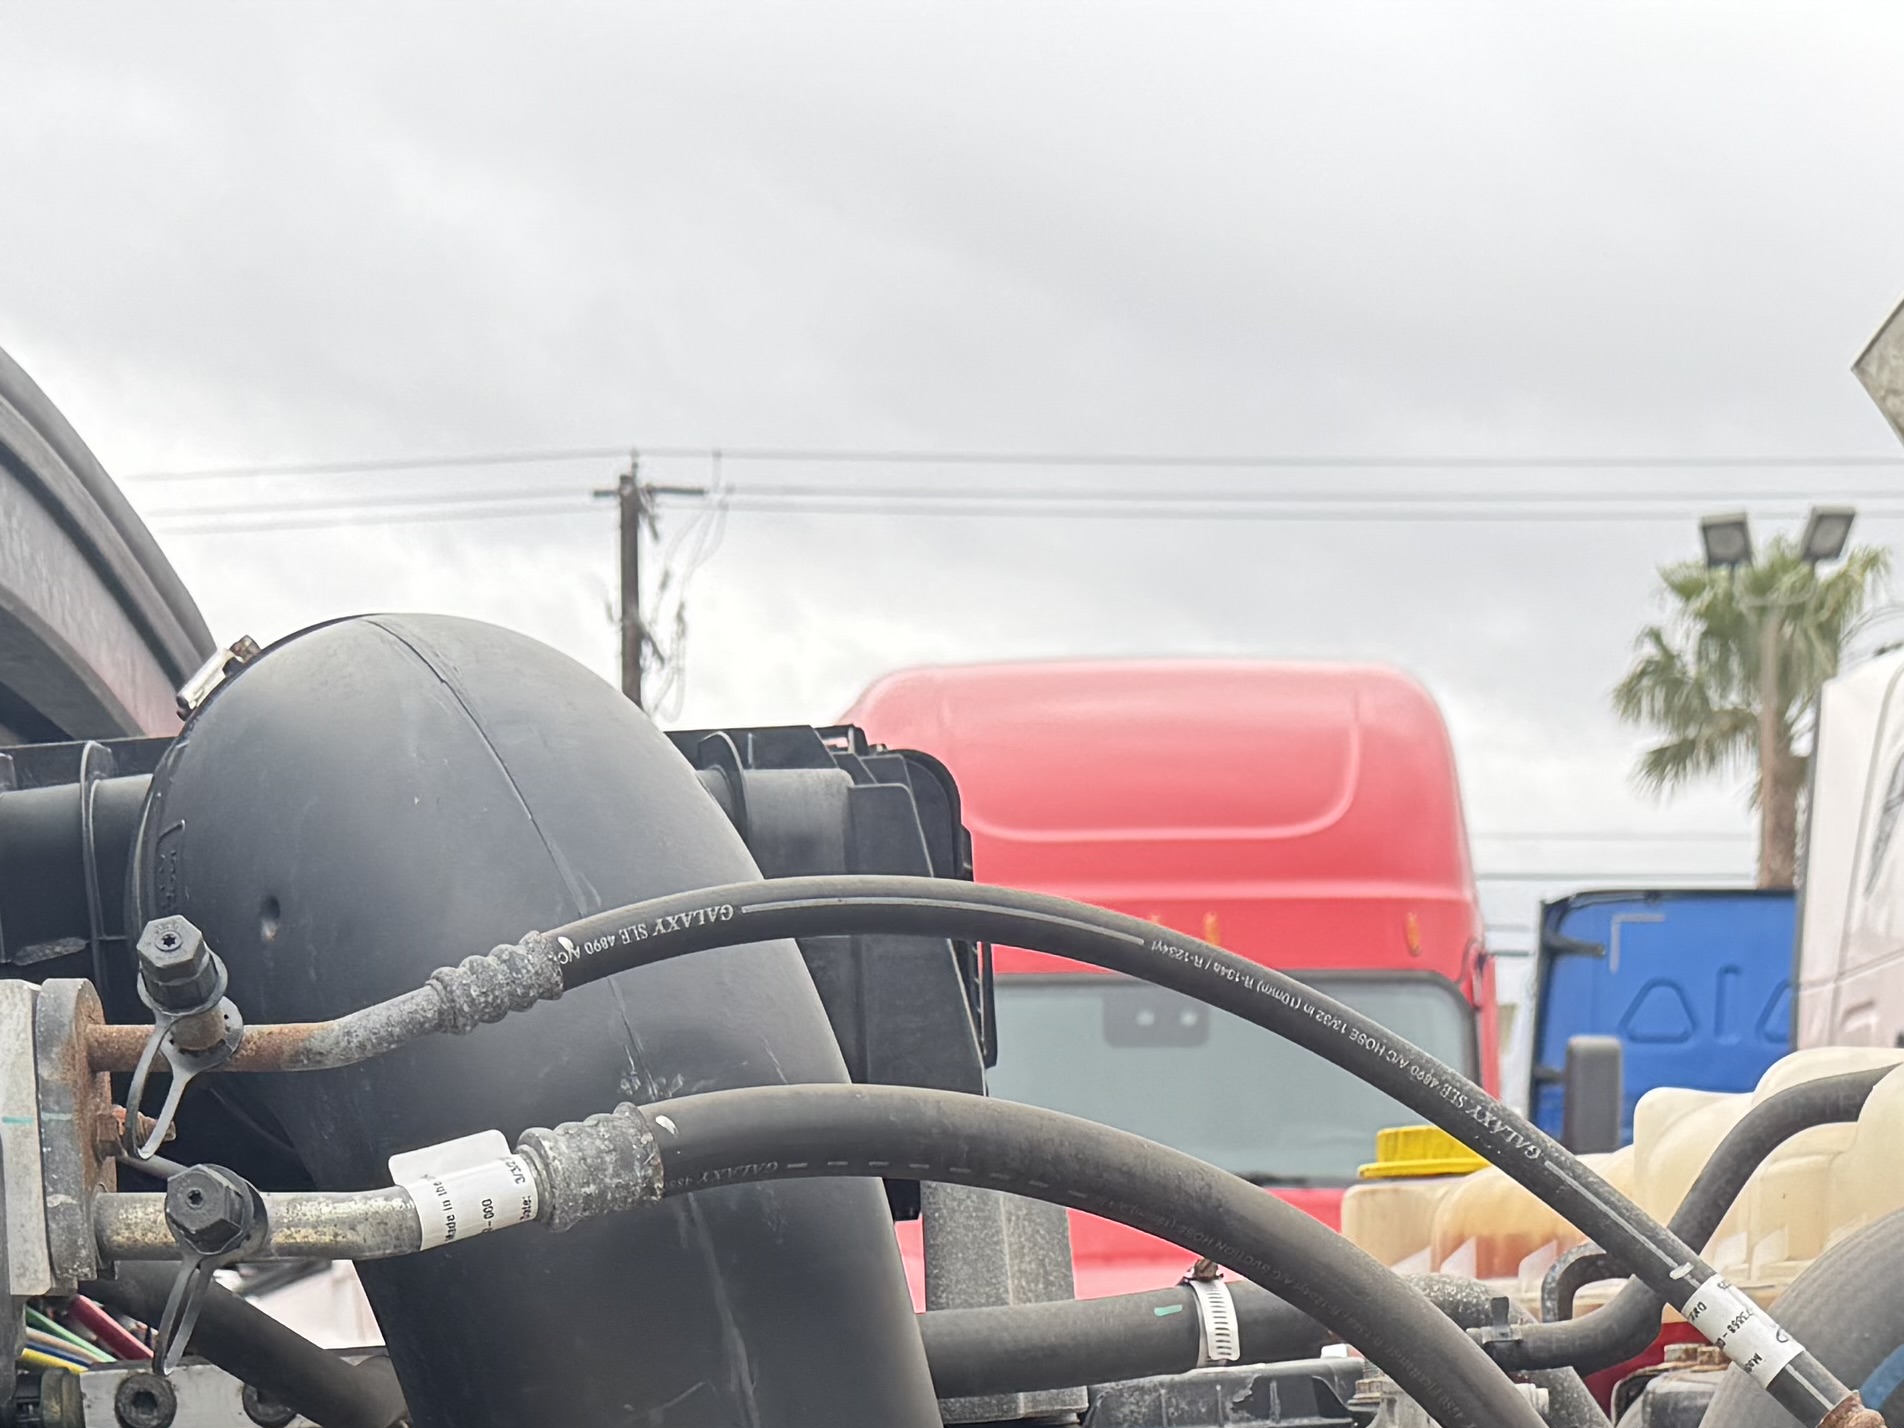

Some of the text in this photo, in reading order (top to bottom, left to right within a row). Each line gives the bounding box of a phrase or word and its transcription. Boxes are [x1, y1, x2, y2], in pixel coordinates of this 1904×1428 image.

[618, 923, 648, 944] SLE
[652, 905, 734, 936] GALAXY
[584, 935, 615, 955] 4890
[1256, 980, 1301, 1011] (10mm)
[1316, 1009, 1347, 1034] 13/32
[1349, 1027, 1386, 1057] HOSE
[1439, 1084, 1468, 1109] SLE
[1466, 1105, 1543, 1160] GALAXY
